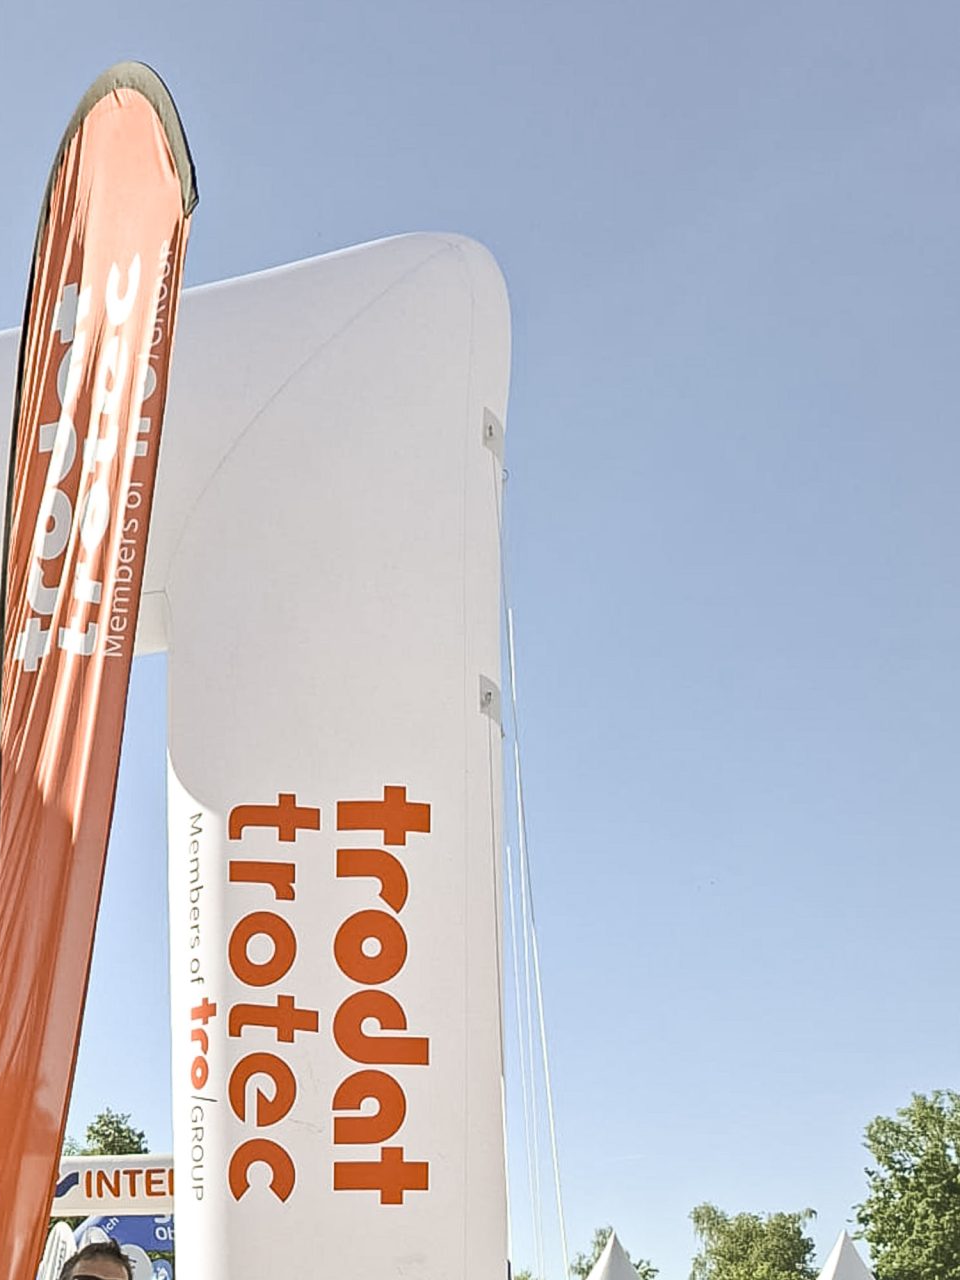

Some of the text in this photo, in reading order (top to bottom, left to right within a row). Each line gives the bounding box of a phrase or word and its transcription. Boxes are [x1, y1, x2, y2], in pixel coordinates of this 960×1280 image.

[15, 283, 91, 672] trodat
[58, 253, 141, 656] trotec
[103, 518, 138, 658] Members
[188, 811, 204, 949] Members
[189, 958, 204, 986] of
[228, 793, 321, 1203] trotec
[333, 785, 431, 1205] trodat
